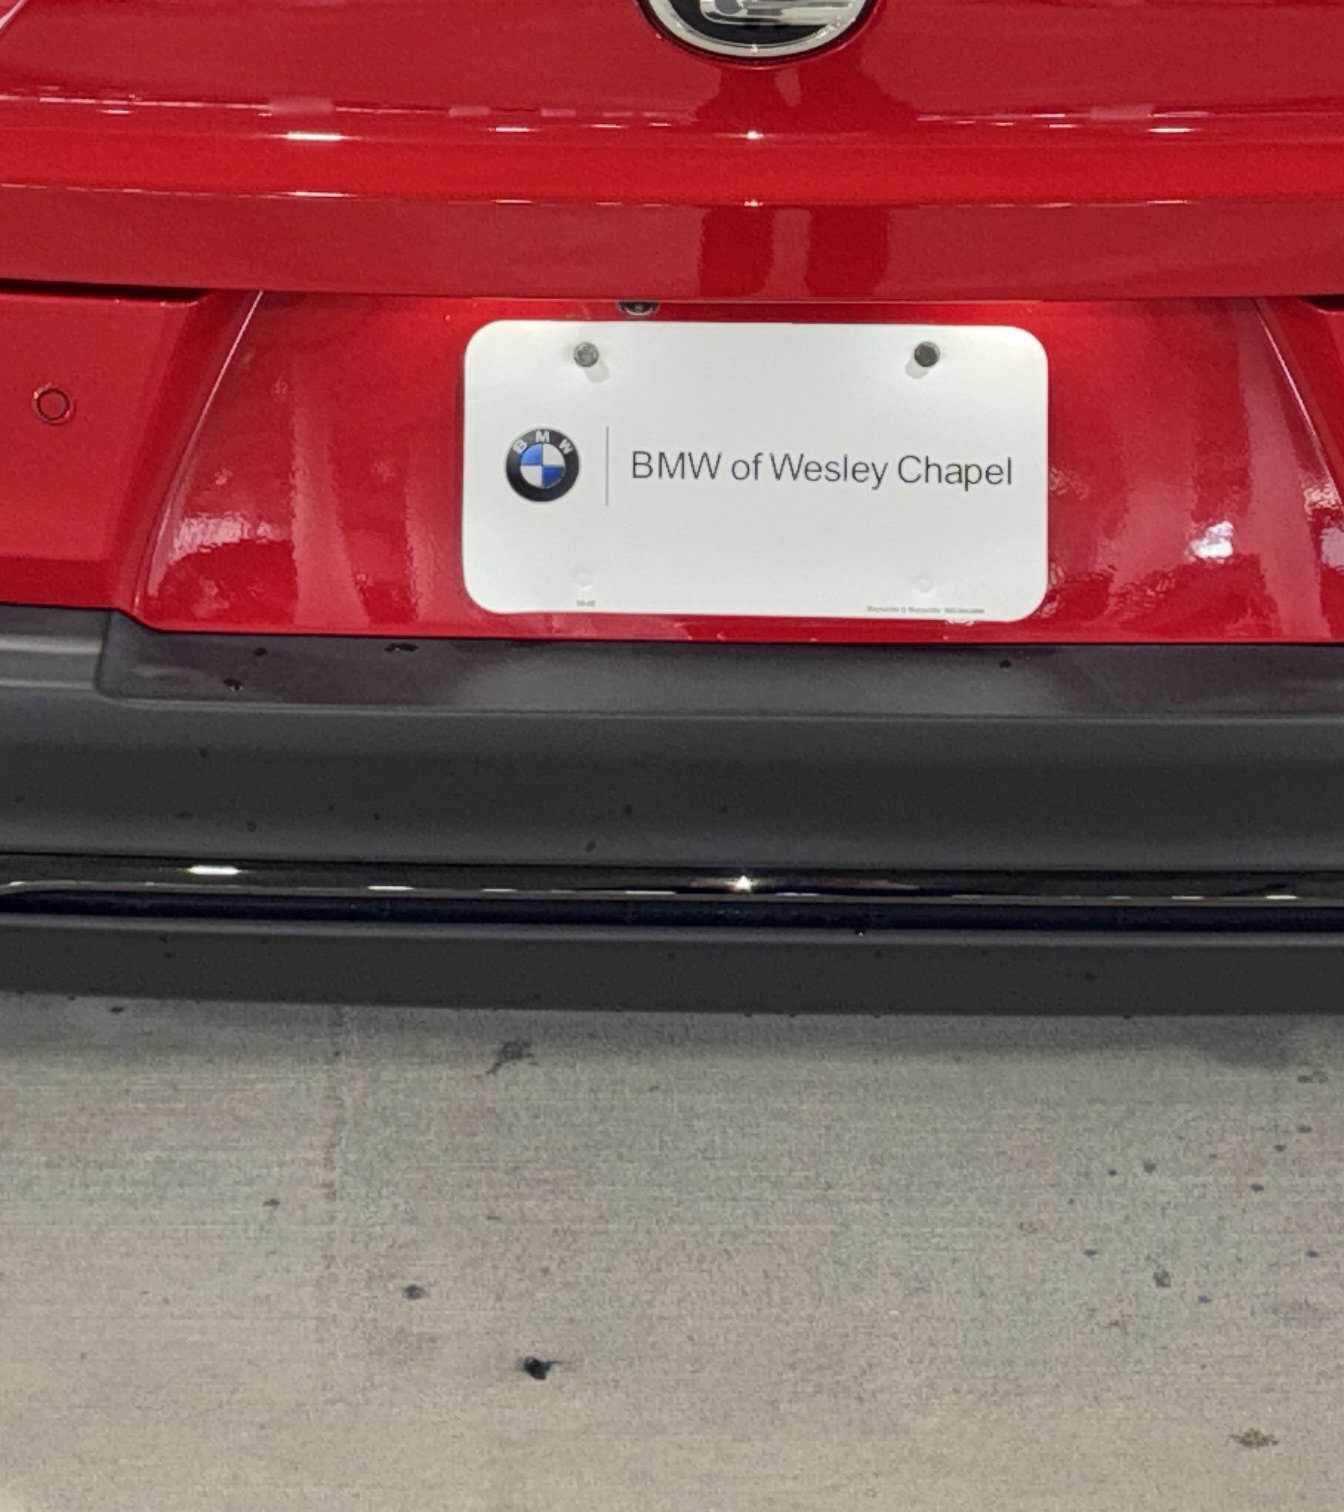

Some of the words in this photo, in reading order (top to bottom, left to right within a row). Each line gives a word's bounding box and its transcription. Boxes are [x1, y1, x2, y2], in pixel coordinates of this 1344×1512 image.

[512, 429, 573, 455] BMW
[632, 450, 722, 480] BMW
[730, 452, 764, 481] of
[769, 452, 889, 491] Wesley
[897, 454, 1013, 492] Chapel
